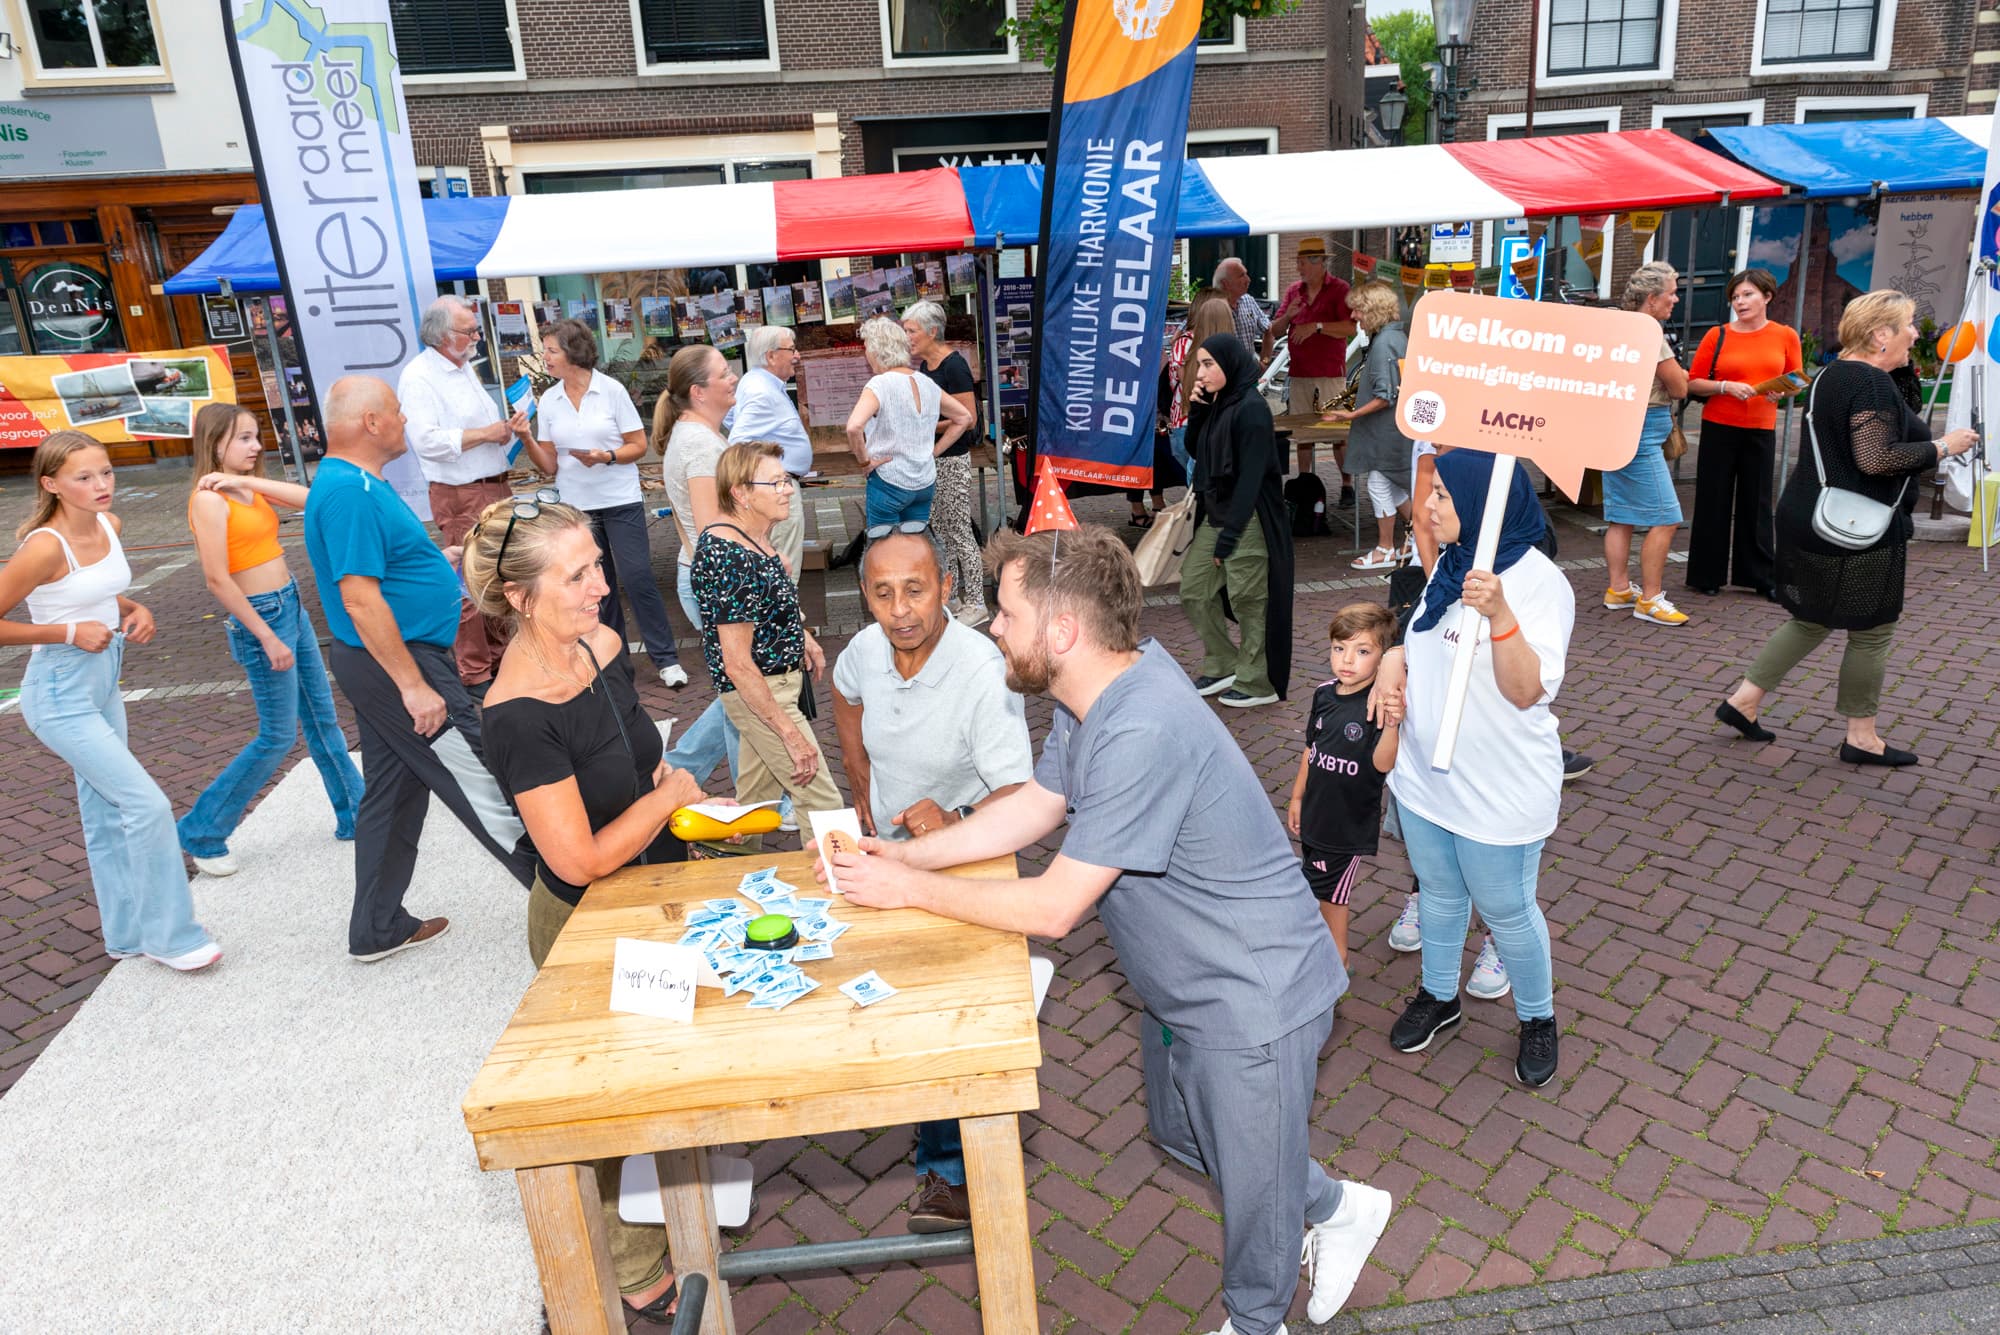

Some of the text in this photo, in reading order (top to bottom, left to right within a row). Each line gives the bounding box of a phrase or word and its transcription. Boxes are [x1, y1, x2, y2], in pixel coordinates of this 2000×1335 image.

[320, 54, 373, 173] meer
[1900, 212, 1933, 221] hebben
[1065, 137, 1114, 431] KONINKLIJKE HARMONIE
[1102, 138, 1164, 436] DE ADELAAR
[28, 297, 113, 315] DenNis
[1427, 312, 1640, 364] Welkom op de
[1416, 355, 1637, 401] Verenigingenmarkt
[0, 408, 57, 421] voor jou?
[1481, 409, 1535, 432] LACH
[0, 426, 61, 441] sgroep.nl
[1052, 466, 1140, 484] WW.ADELAAR-WEESP.NL
[1317, 752, 1359, 776] XBTO
[658, 969, 690, 1003] family
